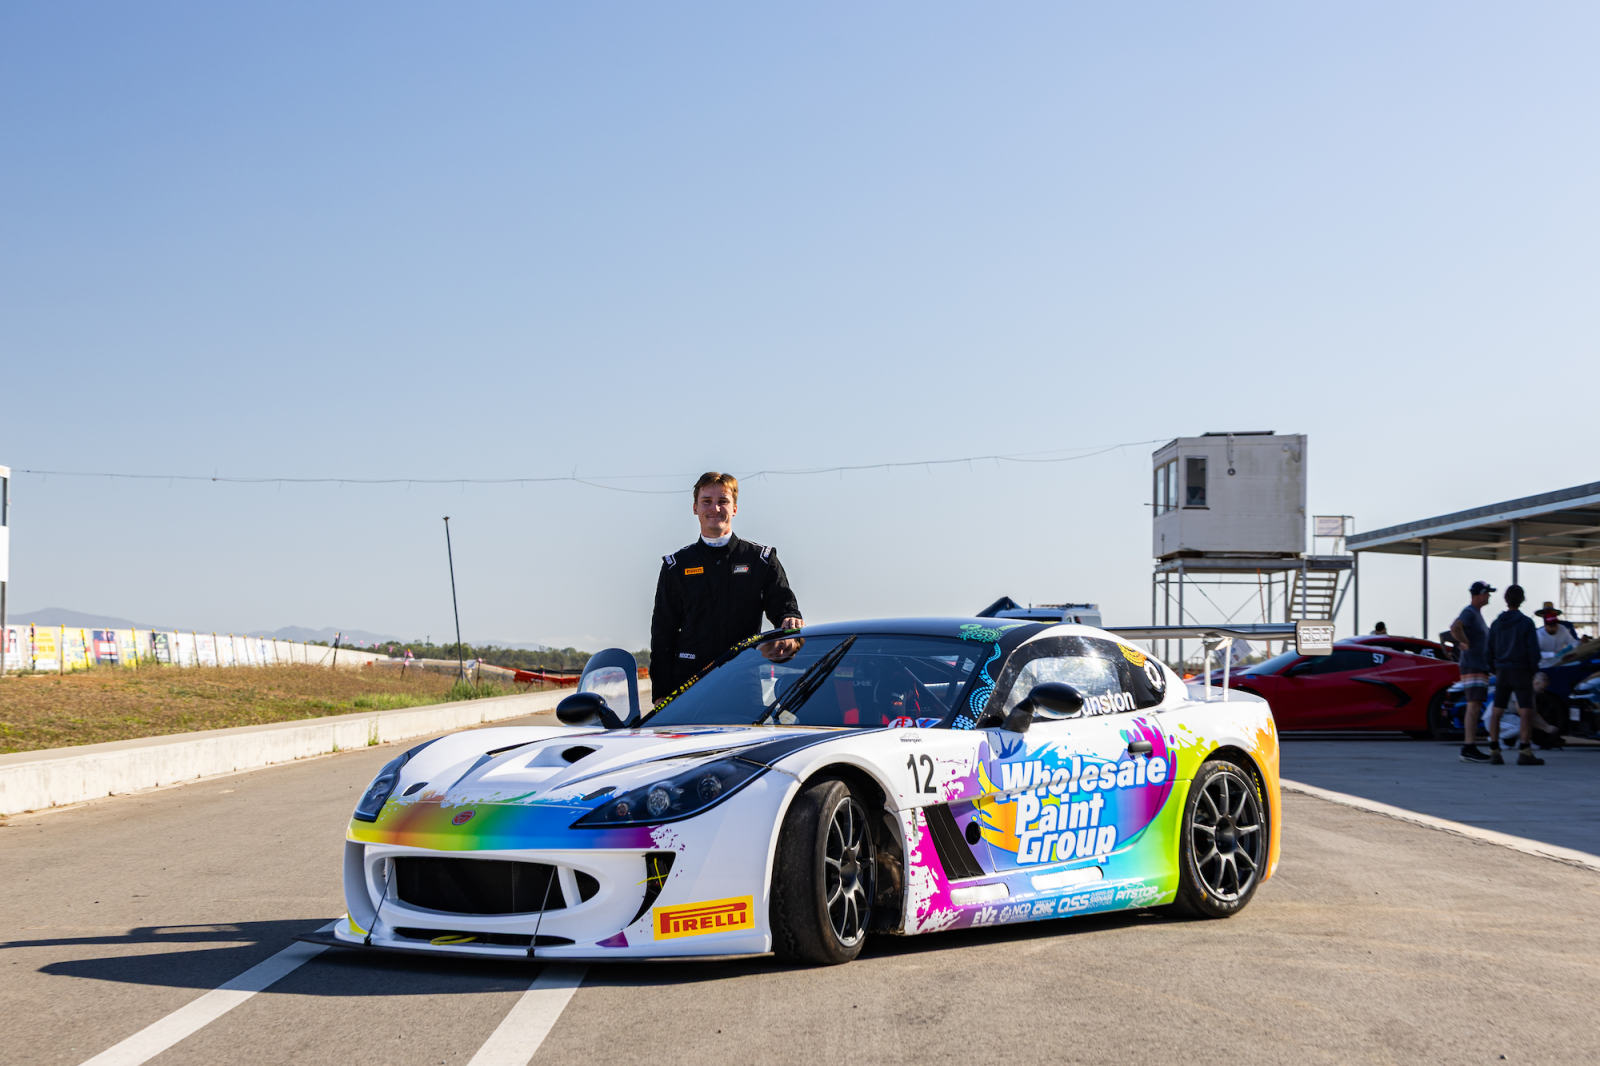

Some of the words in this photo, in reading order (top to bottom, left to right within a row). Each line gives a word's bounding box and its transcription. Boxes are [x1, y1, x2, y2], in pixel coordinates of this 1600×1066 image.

[1372, 653, 1385, 664] 57
[907, 754, 937, 794] 12
[1000, 756, 1167, 800] Wholesale
[1015, 793, 1104, 835] Paint
[1016, 825, 1116, 864] Group
[1012, 903, 1031, 916] NCD
[1057, 893, 1090, 913] QSS
[1115, 886, 1159, 901] PITSTOP
[660, 902, 747, 934] PIRELLI
